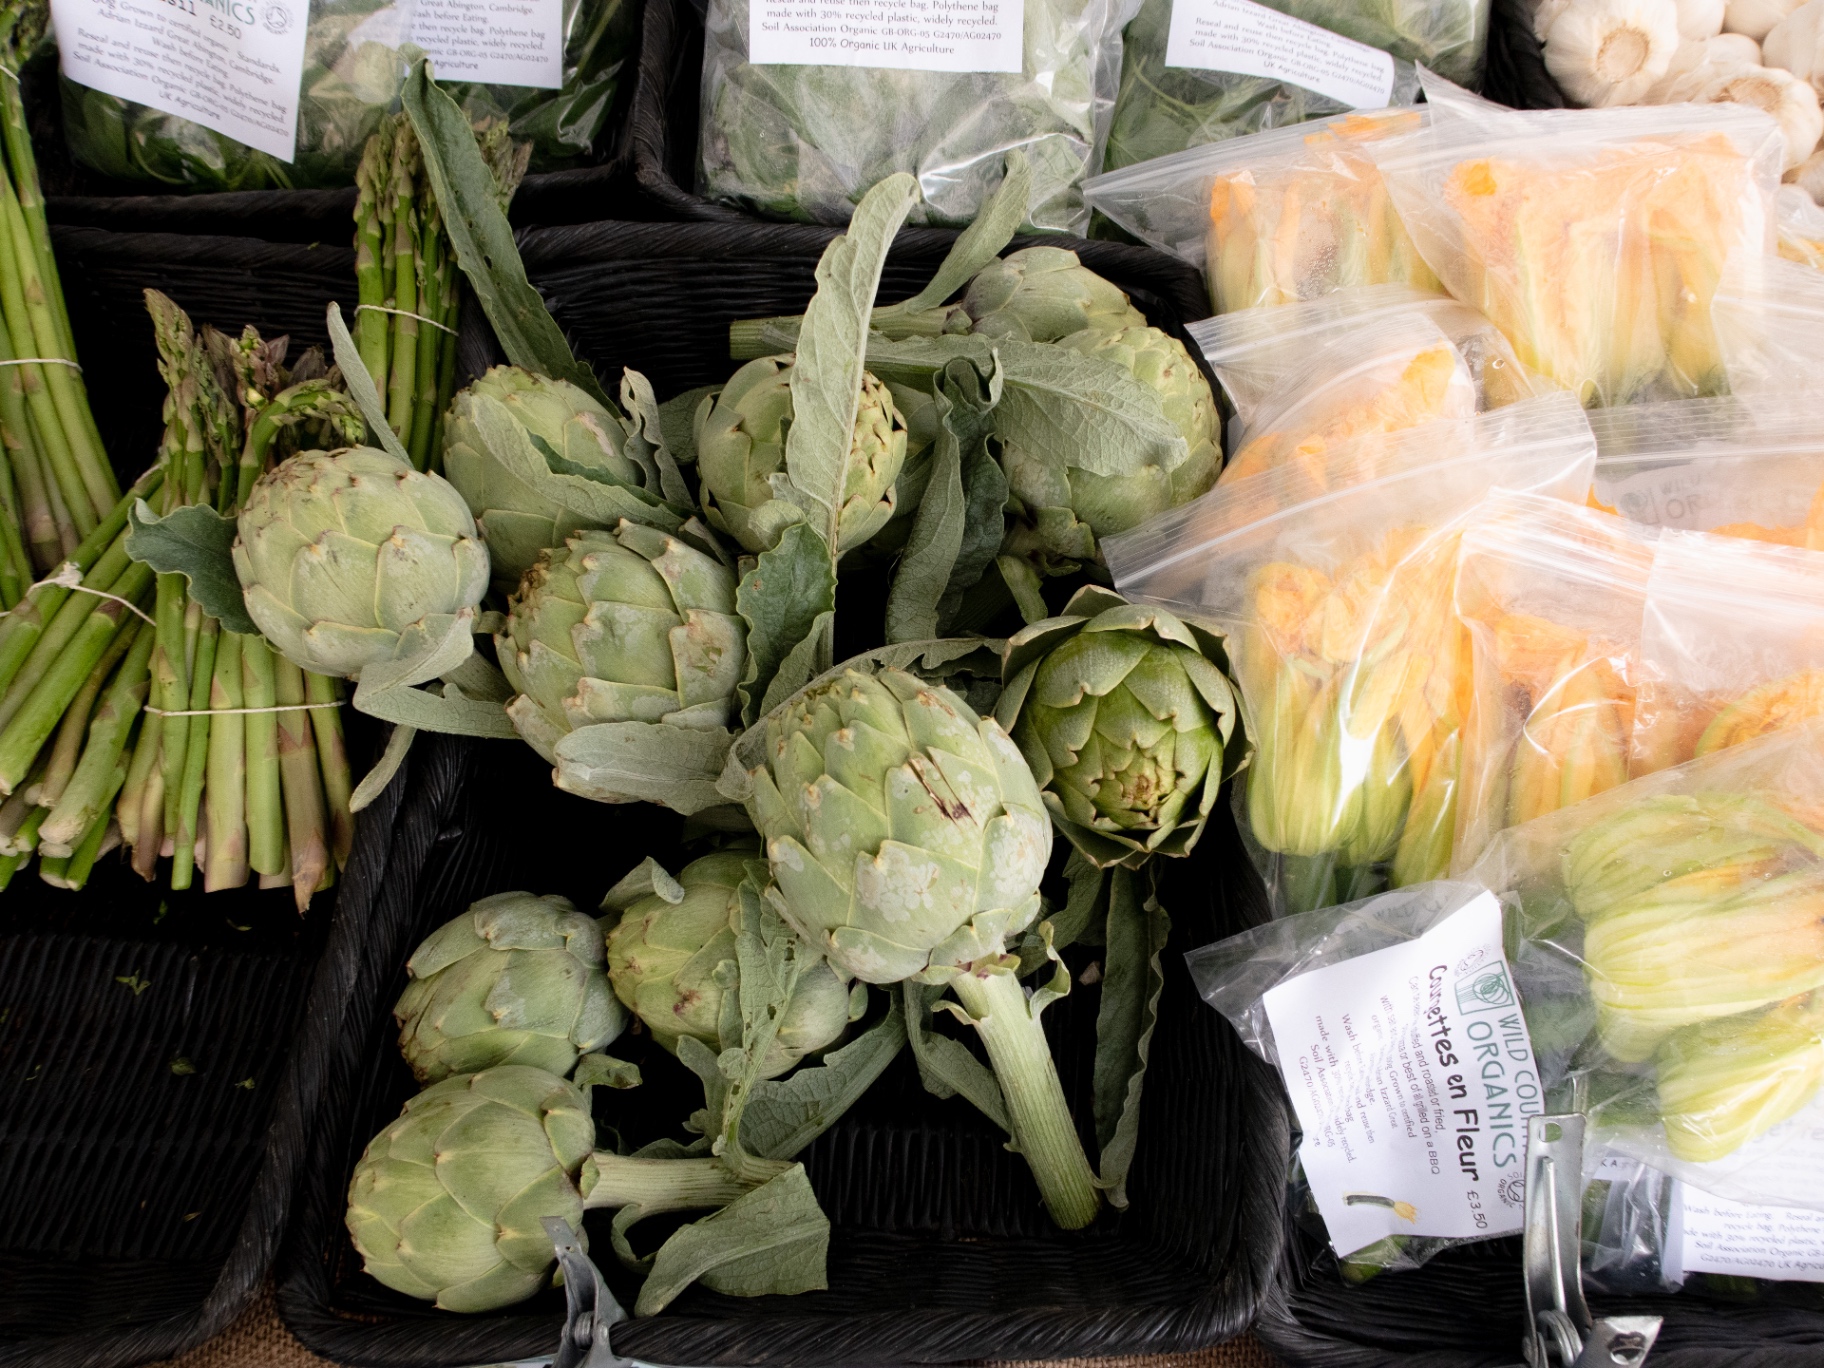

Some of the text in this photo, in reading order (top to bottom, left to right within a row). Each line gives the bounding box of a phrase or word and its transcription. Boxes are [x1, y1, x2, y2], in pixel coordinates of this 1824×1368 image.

[434, 10, 460, 21] before
[462, 13, 489, 24] Eating.
[488, 2, 534, 15] Cambridge.
[910, 0, 929, 11] bag.
[933, 0, 979, 13] Polythene
[982, 0, 999, 13] bag
[1212, 0, 1240, 12] Adrian
[98, 8, 132, 24] Adrian
[134, 18, 165, 35] Izzard
[166, 29, 190, 45] Great
[119, 1, 154, 17] Grown
[156, 13, 167, 22] to
[168, 19, 201, 38] certified
[202, 35, 229, 52] organic
[209, 14, 242, 40] £2.50
[767, 8, 998, 28] made with 30% recycled plastic, widely recycled.
[1256, 20, 1278, 31] Wash
[418, 22, 437, 31] then
[440, 23, 468, 34] recycle
[489, 26, 529, 38] Polythene
[531, 29, 546, 40] bag
[761, 22, 1002, 41] Soil Association Organic GB-ORG-05 G2470/AG02470
[152, 36, 177, 52] Wash
[179, 46, 204, 64] before
[416, 34, 545, 51] recycled plastic, widely recycled.
[809, 37, 955, 54] 100% Organic UK Agriculture
[1189, 38, 1206, 48] Soil
[1207, 41, 1255, 55] Association
[1256, 48, 1288, 62] Organic
[1195, 17, 1386, 74] Reseal and reuse then recycle Polythene bag
[1195, 29, 1218, 38] made
[1220, 32, 1239, 41] with
[1241, 36, 1260, 47] 30%
[1262, 41, 1294, 55] recycled
[1325, 58, 1350, 72] widely
[434, 59, 479, 70] Agriculture
[446, 49, 488, 59] GB-ORG-05
[72, 50, 91, 63] Soil
[93, 57, 149, 80] Association
[151, 74, 187, 93] Organic
[77, 27, 109, 43] Reseal
[111, 40, 131, 50] and
[133, 46, 160, 59] reuse
[161, 53, 182, 66] then
[184, 62, 210, 80] recycle
[228, 82, 269, 106] Polythene
[78, 42, 104, 55] made
[107, 50, 129, 62] with
[157, 65, 193, 84] recycled
[221, 93, 247, 110] widely
[1263, 60, 1321, 83] UK Agriculture
[158, 90, 221, 121] UK Agriculture
[1342, 1013, 1358, 1042] Wash
[1498, 1013, 1529, 1062] WILD
[1315, 1015, 1330, 1042] made
[1325, 1045, 1339, 1068] with
[1310, 1044, 1325, 1063] Soil
[1400, 1051, 1409, 1060] or
[1414, 1050, 1429, 1068] and
[1402, 1061, 1418, 1083] best
[1389, 1070, 1404, 1101] Grown
[1410, 1082, 1422, 1094] of
[1447, 1074, 1468, 1099] en
[1467, 1021, 1518, 1168] ORGANICS
[1379, 1086, 1396, 1112] Izzard
[1398, 1100, 1406, 1108] to
[1430, 1097, 1440, 1107] or
[1360, 1111, 1371, 1130] reuse
[1366, 1130, 1376, 1144] then
[1400, 1108, 1418, 1139] certified
[1433, 1108, 1447, 1134] fried,
[1421, 1126, 1433, 1139] on
[1426, 1141, 1434, 1149] a
[1453, 1109, 1480, 1182] Fleur
[1428, 1150, 1441, 1176] BBQ
[1466, 1190, 1489, 1230] £3.50
[1713, 1208, 1742, 1219] before
[1694, 1240, 1713, 1249] Soil
[1717, 1244, 1767, 1254] Association
[1769, 1247, 1806, 1258] Organic
[1702, 1231, 1723, 1240] with
[1749, 1234, 1785, 1245] recycled
[1777, 1260, 1791, 1269] UK
